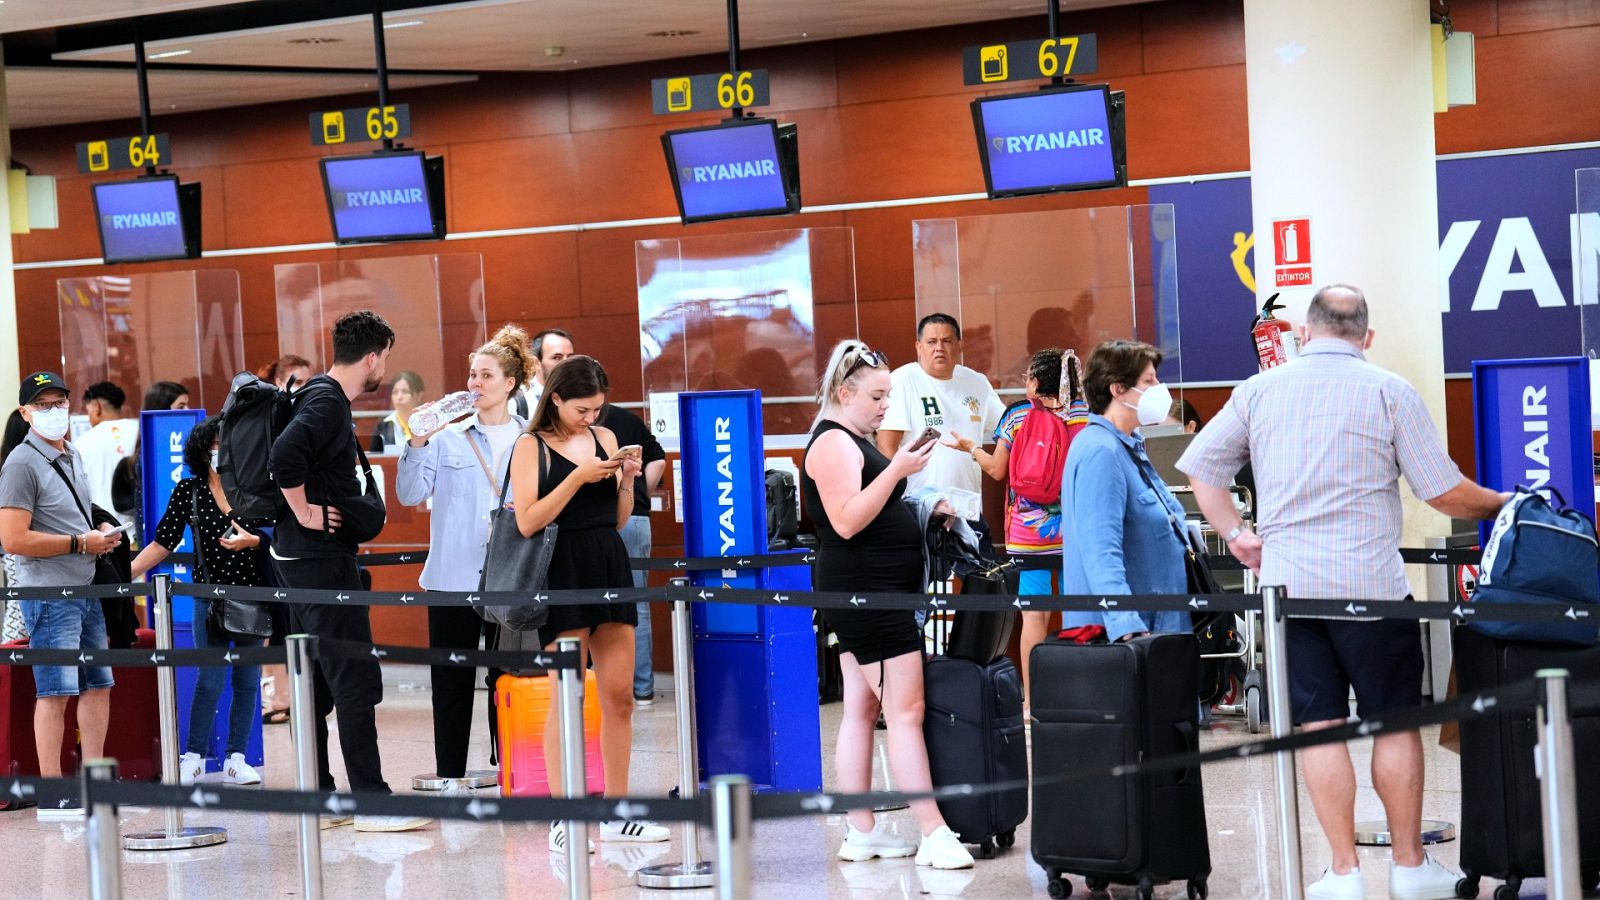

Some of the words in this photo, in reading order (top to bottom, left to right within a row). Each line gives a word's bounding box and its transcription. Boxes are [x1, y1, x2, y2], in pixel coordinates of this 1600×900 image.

[1038, 36, 1079, 77] 67
[717, 71, 754, 108] 66
[366, 105, 399, 140] 65
[129, 134, 159, 167] 64
[1006, 128, 1104, 153] RYANAIR
[693, 159, 776, 183] RYANAIR
[346, 188, 423, 207] RYANAIR
[112, 211, 177, 229] RYANAIR
[1276, 272, 1310, 282] EXTINTOR
[921, 396, 941, 416] H
[924, 416, 944, 427] 1986
